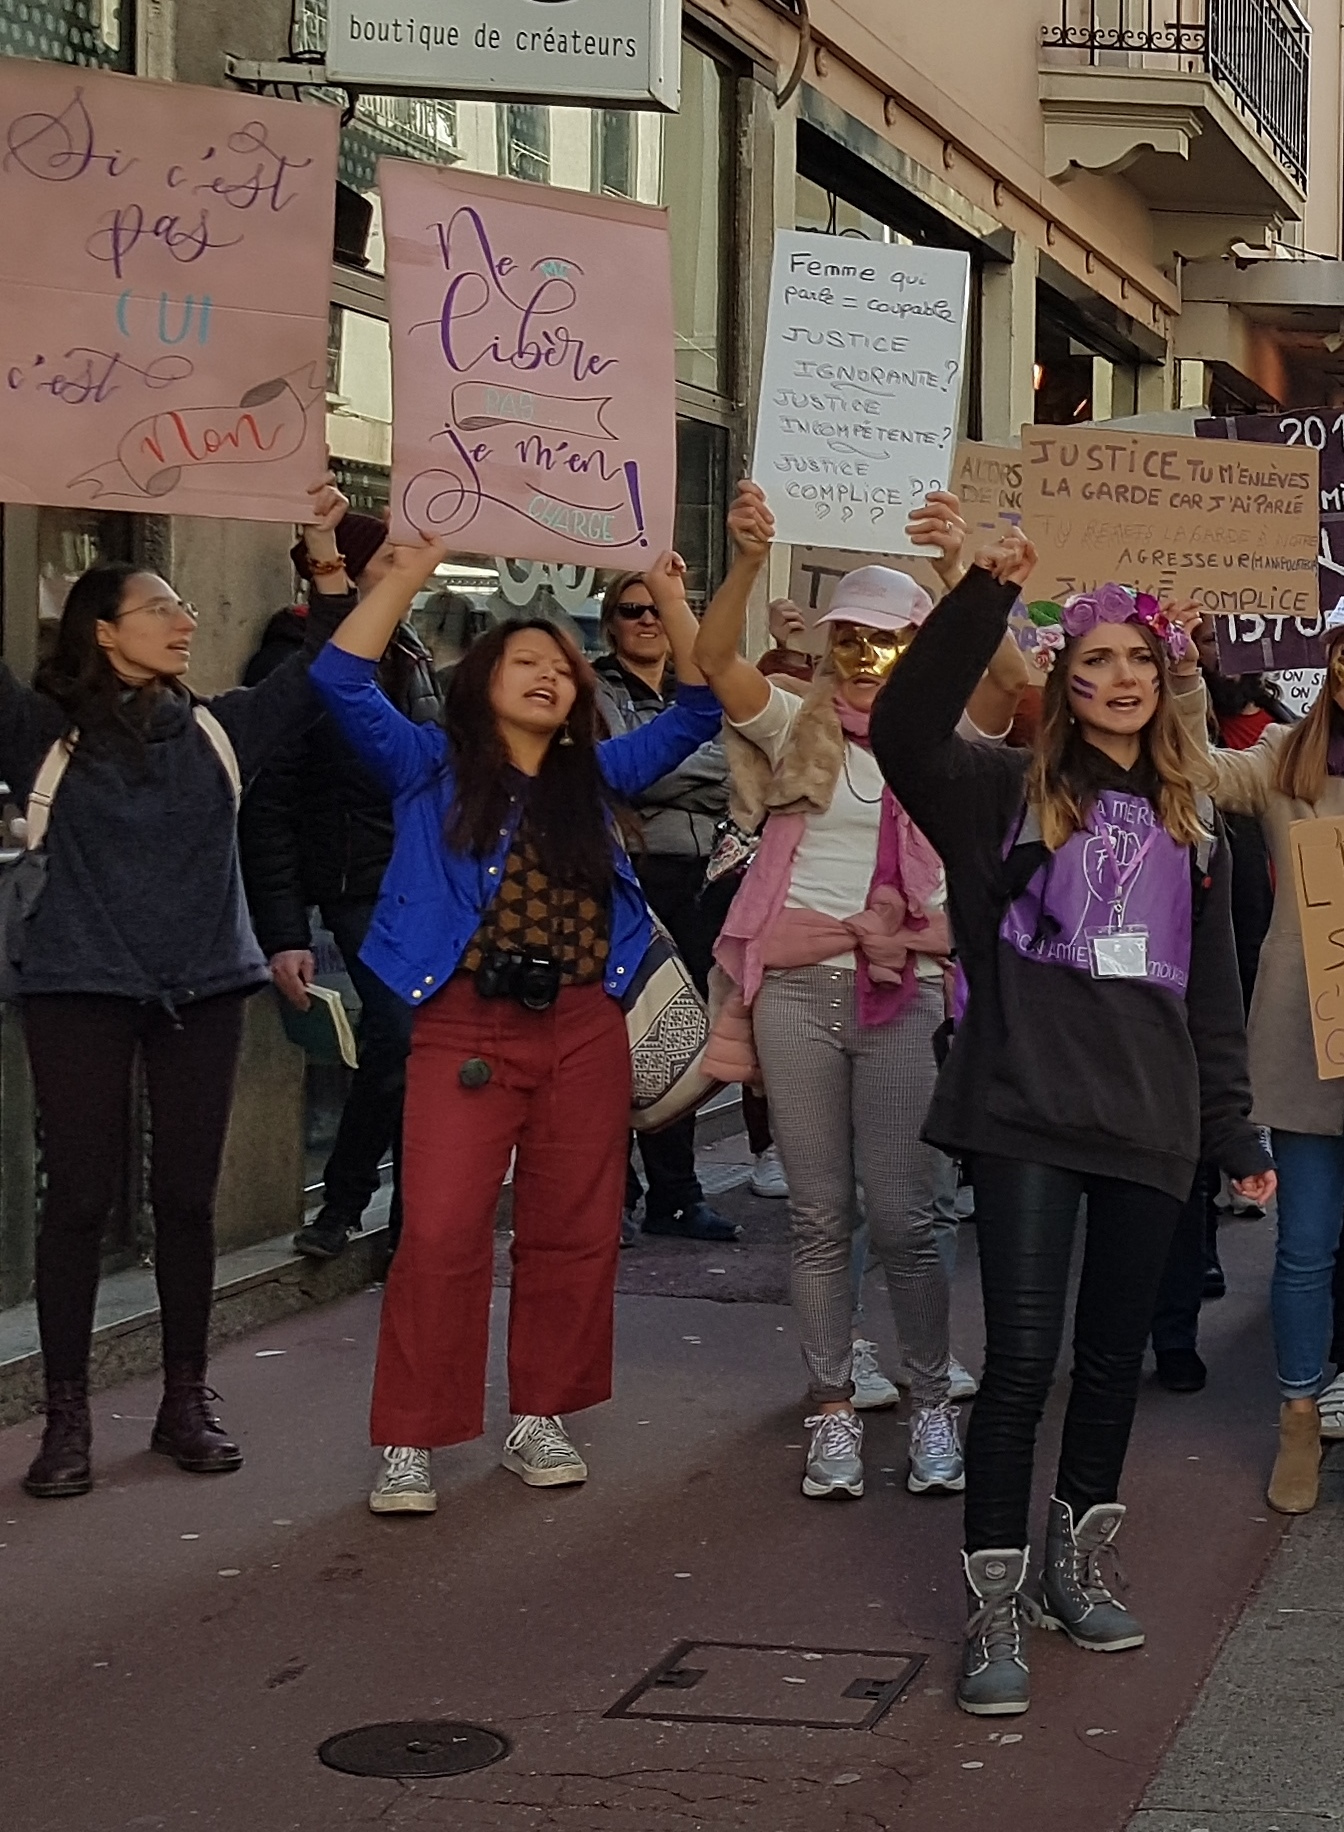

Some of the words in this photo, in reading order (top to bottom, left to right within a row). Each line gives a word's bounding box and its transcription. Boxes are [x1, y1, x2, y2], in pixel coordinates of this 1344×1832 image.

[350, 15, 459, 50] boutique
[474, 23, 500, 49] de
[516, 27, 637, 58] créateurs
[3, 86, 139, 181] Si
[85, 203, 245, 279] pas
[426, 206, 526, 311] Ne
[791, 253, 875, 281] Femme
[890, 272, 928, 293] qui
[785, 286, 834, 305] parle
[867, 298, 957, 324] coupable
[782, 327, 910, 353] JUSTICE
[773, 388, 881, 416] JUSTICE
[773, 453, 869, 477] JUSTICE
[1187, 459, 1213, 482] TU
[1219, 462, 1310, 490] M'ENLÈVES
[1041, 479, 1071, 498] LA
[1082, 482, 1162, 506] GARDE
[1170, 492, 1203, 510] CAR
[1254, 495, 1304, 515] PARLÉ
[528, 495, 615, 541] CHARGE
[1033, 515, 1072, 548] TU
[1164, 525, 1187, 542] LA
[1114, 547, 1250, 573] AGRESSEUR
[1283, 670, 1304, 683] ON
[1291, 686, 1311, 699] ON
